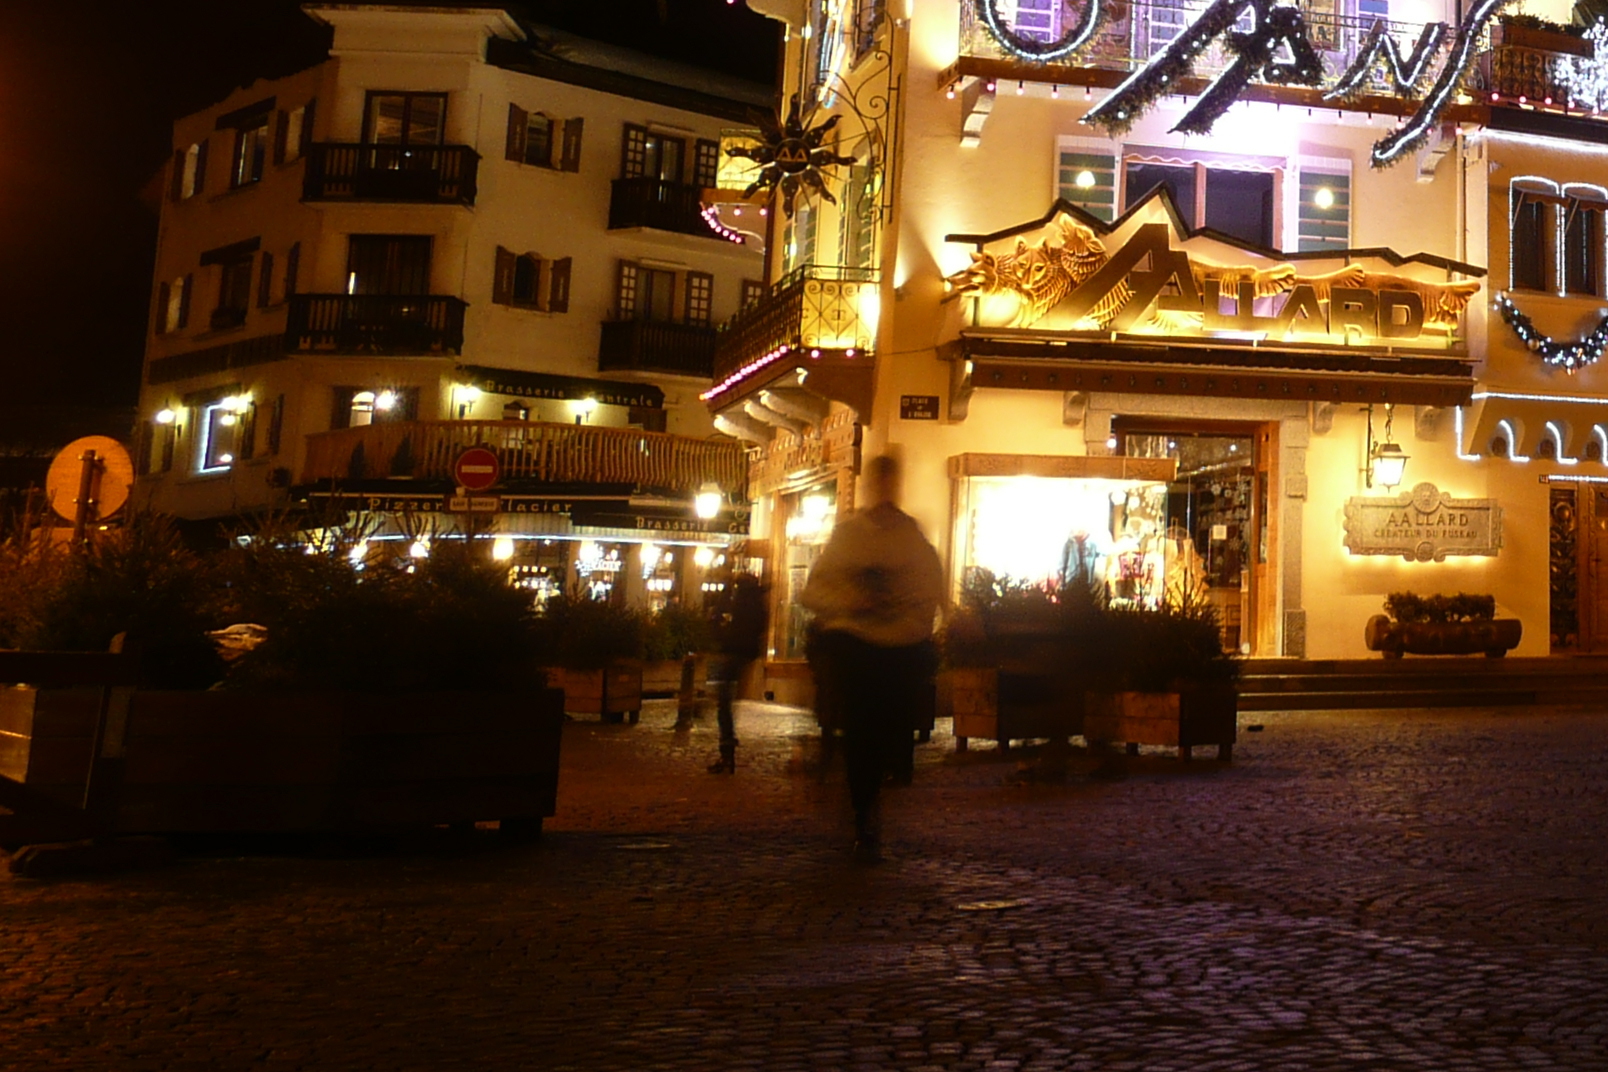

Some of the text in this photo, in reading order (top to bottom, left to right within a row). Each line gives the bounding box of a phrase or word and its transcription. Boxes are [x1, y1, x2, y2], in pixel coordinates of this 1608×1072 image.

[485, 379, 654, 407] Brasserie entrale
[367, 497, 443, 512] Pizzer
[501, 499, 573, 513] lacier
[635, 515, 710, 531] Brasserie
[1426, 529, 1439, 539] DU
